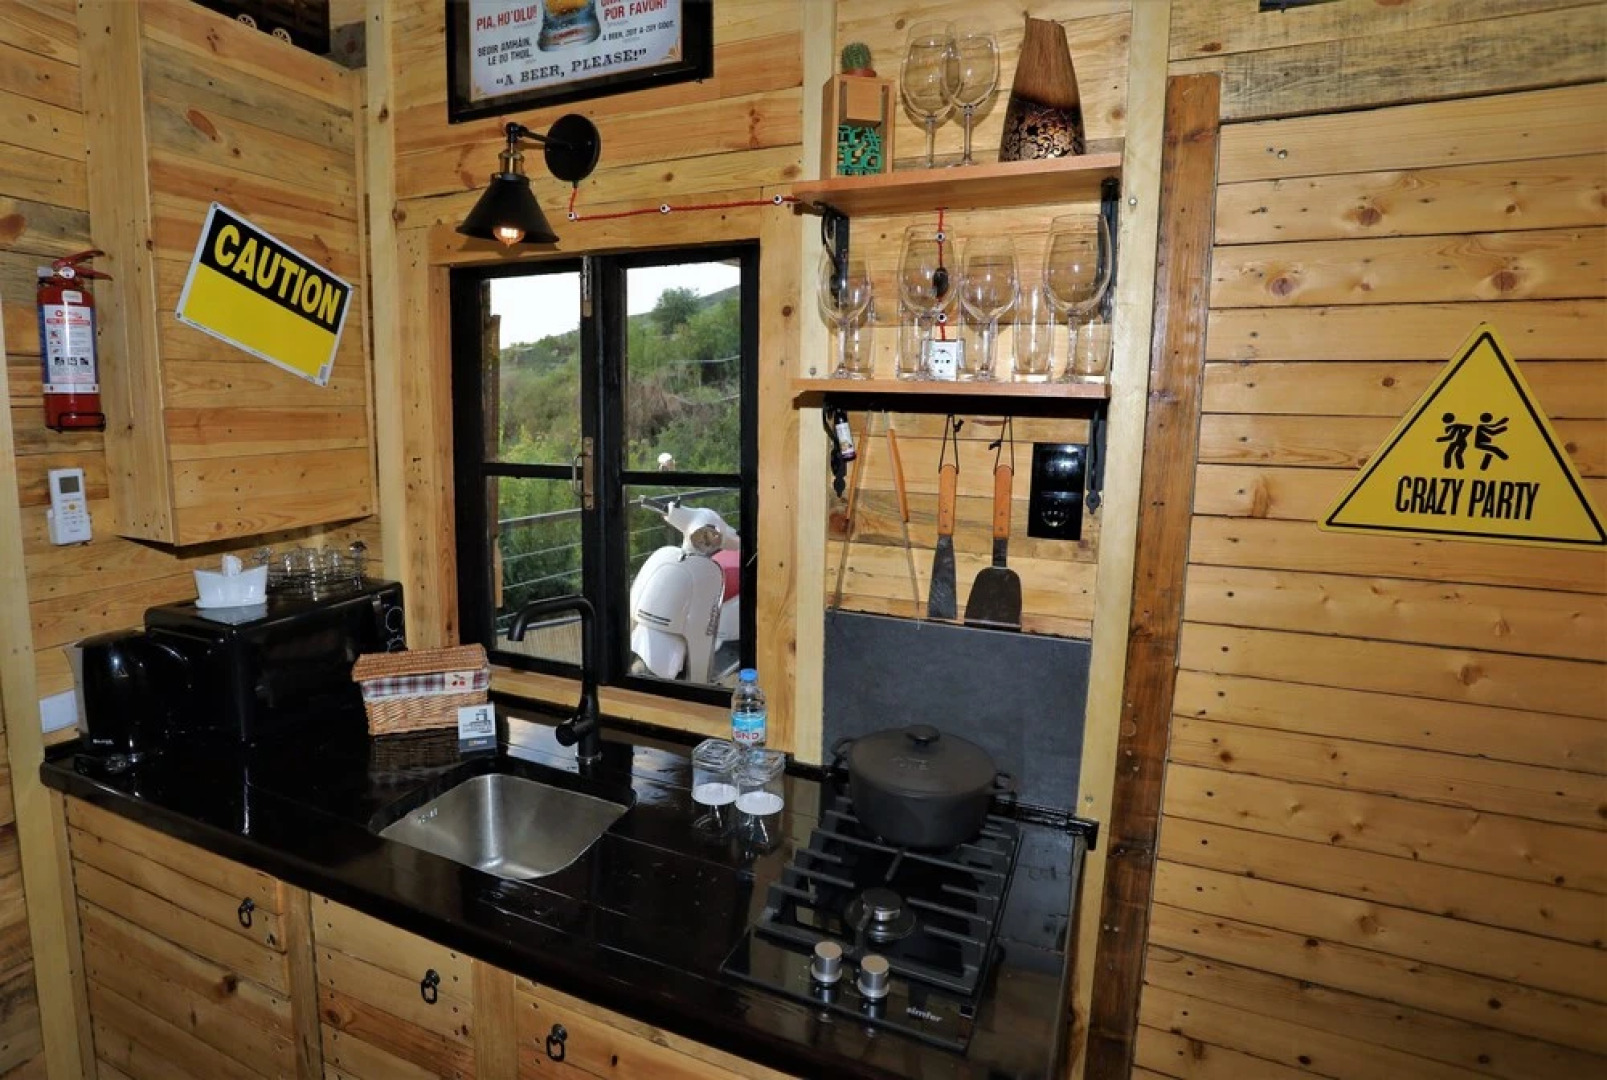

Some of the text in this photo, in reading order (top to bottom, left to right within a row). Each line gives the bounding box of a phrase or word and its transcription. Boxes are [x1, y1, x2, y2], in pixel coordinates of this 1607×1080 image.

[603, 5, 625, 21] POR
[520, 64, 565, 83] BEER,
[213, 224, 342, 325] CAUTION
[1395, 475, 1540, 520] CRAZY PARTY
